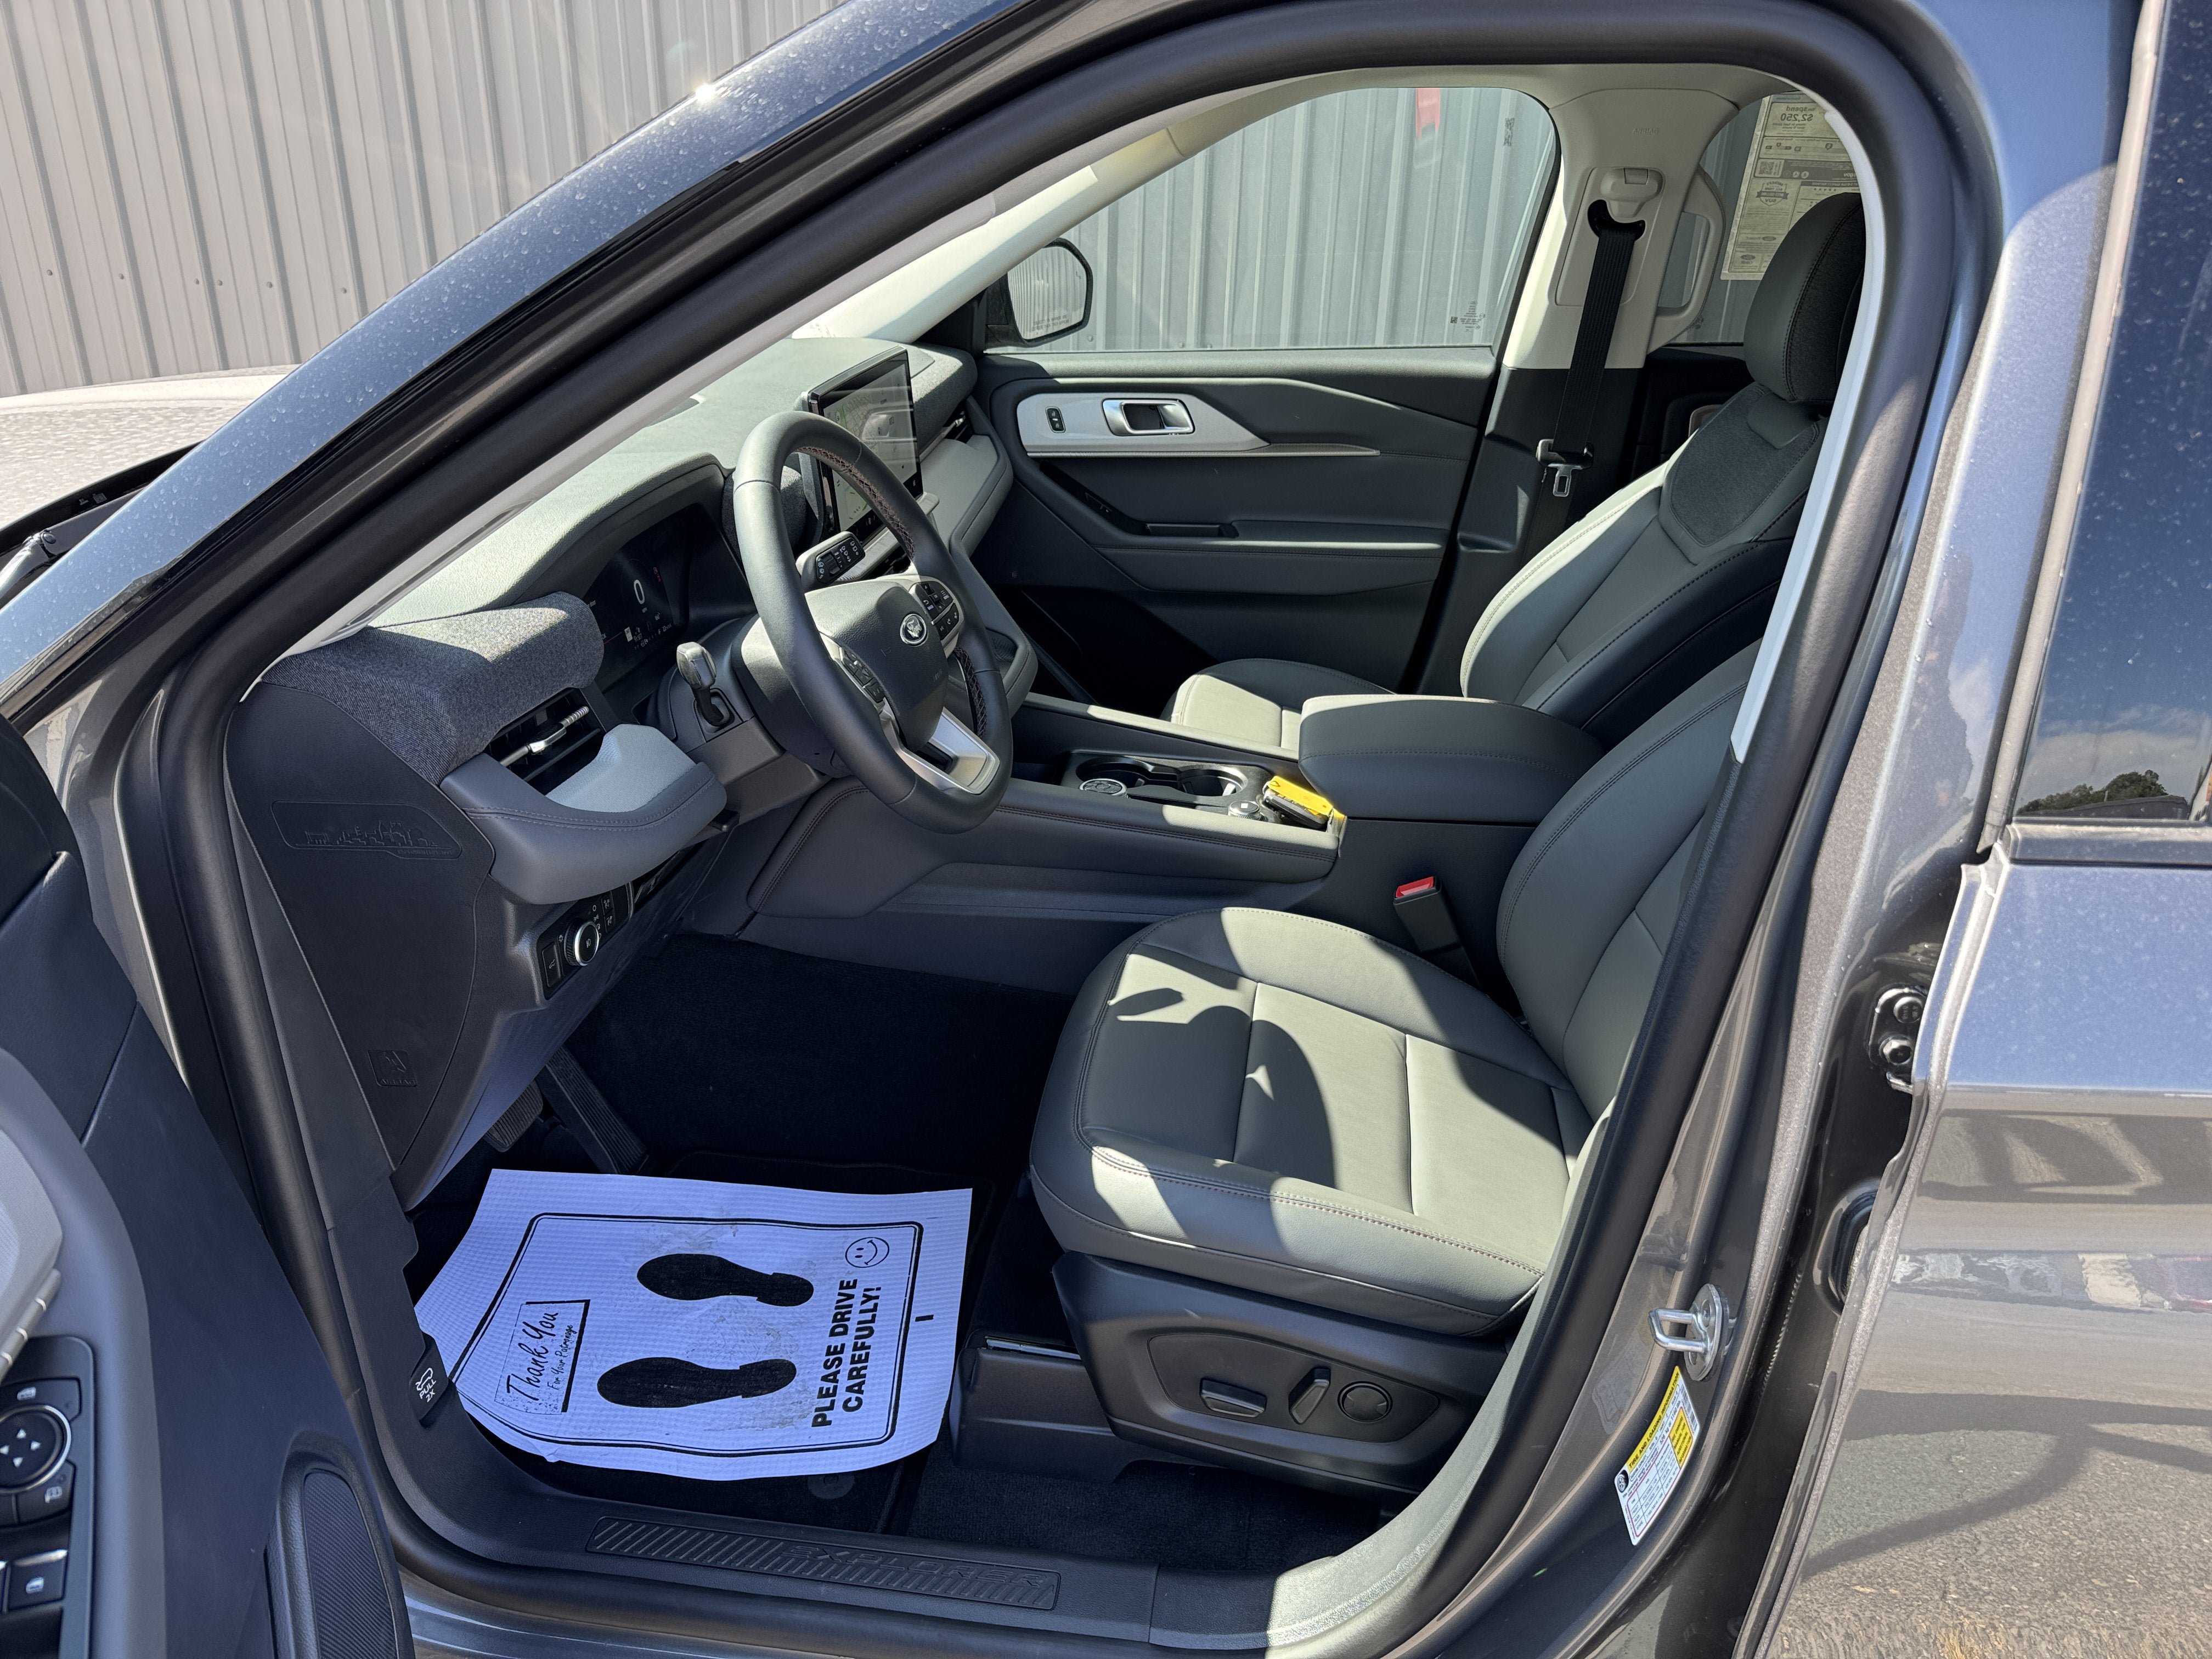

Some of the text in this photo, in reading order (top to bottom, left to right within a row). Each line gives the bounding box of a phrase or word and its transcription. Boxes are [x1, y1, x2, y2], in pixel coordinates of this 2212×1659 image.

[634, 579, 645, 604] 0
[506, 1312, 558, 1401] Thank You
[548, 1324, 577, 1390] For Your Patronage
[811, 1279, 857, 1427] PLEASE DRIVE
[842, 1286, 881, 1412] CAREFULLY!
[419, 1379, 436, 1400] PULL
[426, 1389, 435, 1402] 2X
[1629, 1369, 1679, 1469] TIRE AND LOADING INFORMATION
[782, 1545, 1047, 1587] EXPLORER
